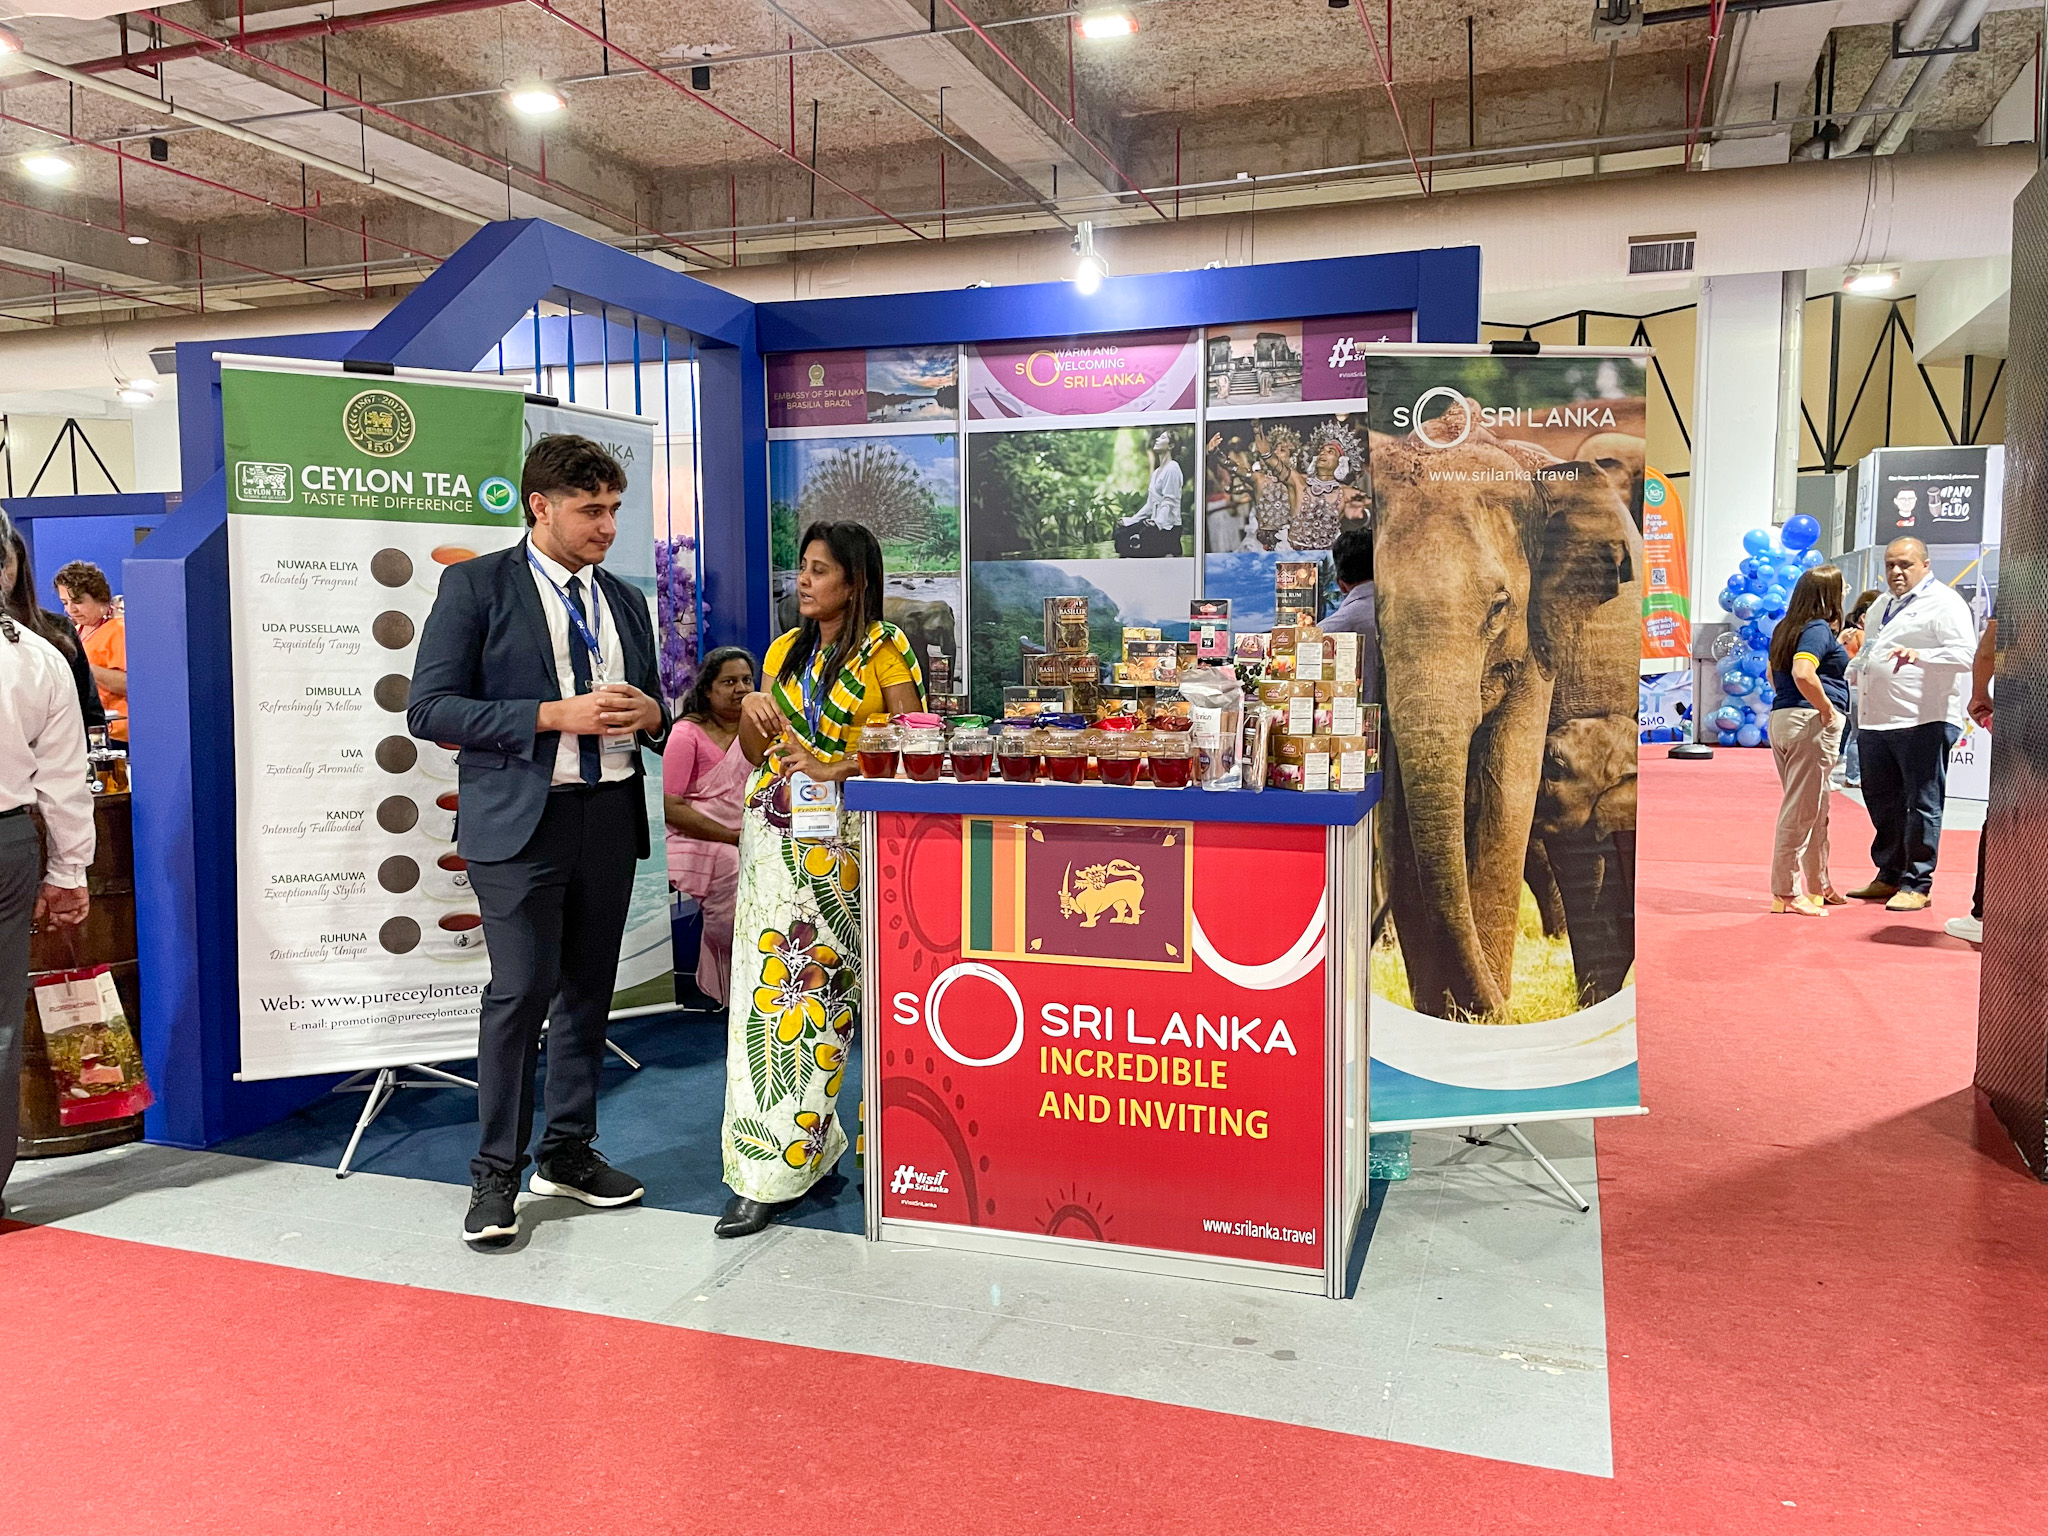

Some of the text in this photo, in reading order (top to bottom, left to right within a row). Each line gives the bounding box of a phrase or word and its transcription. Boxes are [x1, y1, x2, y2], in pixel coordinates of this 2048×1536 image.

[1054, 345, 1118, 358] WARM AND
[1054, 358, 1125, 371] WELCOMING
[1063, 375, 1088, 388] SRI
[1091, 372, 1146, 388] LANKA
[774, 388, 865, 401] EMBASSY OF SRI LANKA
[354, 394, 376, 410] 1867
[381, 396, 404, 412] 2017
[824, 400, 852, 408] BRAZIL
[1480, 406, 1521, 427] SRI
[1527, 406, 1617, 427] LANKA
[366, 441, 395, 453] 150
[600, 441, 635, 461] NKA
[301, 465, 413, 495] CEYLON
[422, 472, 473, 498] TEA
[1429, 467, 1579, 482] www.srilanka.travel
[243, 487, 287, 497] CEYLON TEA
[301, 492, 473, 513] TASTE THE DIFFERENCE
[1941, 502, 1970, 517] ELDO
[277, 560, 359, 571] NUWARA ELIYA
[260, 571, 359, 591] Delicately Fragrant
[262, 623, 360, 634] UDA PUSSELLAWA
[272, 636, 361, 655] Exquisitely Tangy
[305, 687, 362, 696] DIMBULLA
[259, 699, 363, 717] Refreshingly Mellow
[1639, 716, 1665, 726] SMO
[341, 749, 364, 758] UVA
[1950, 751, 1974, 765] IAR
[266, 761, 364, 779] Exotically Aromatic
[326, 810, 365, 820] KANDY
[261, 820, 365, 839] Intensely Fullbodied
[271, 871, 366, 884] SABARAGAMUWA
[264, 882, 366, 903] Exceptionally Stylish
[320, 932, 367, 944] RUHUNA
[269, 945, 368, 962] Distinctively Unique
[260, 984, 486, 1012] Web: www.pureceylontea.
[290, 1007, 483, 1031] E-mail: promotion@pureceylontea.co
[1040, 1002, 1114, 1042] SRI
[1127, 1008, 1298, 1057] LANKA
[1039, 1046, 1229, 1090] INCREDIBLE
[1038, 1090, 1269, 1140] AND INVITING
[914, 1183, 949, 1194] SriLanka
[1202, 1218, 1316, 1245] www.srilanka.travel
